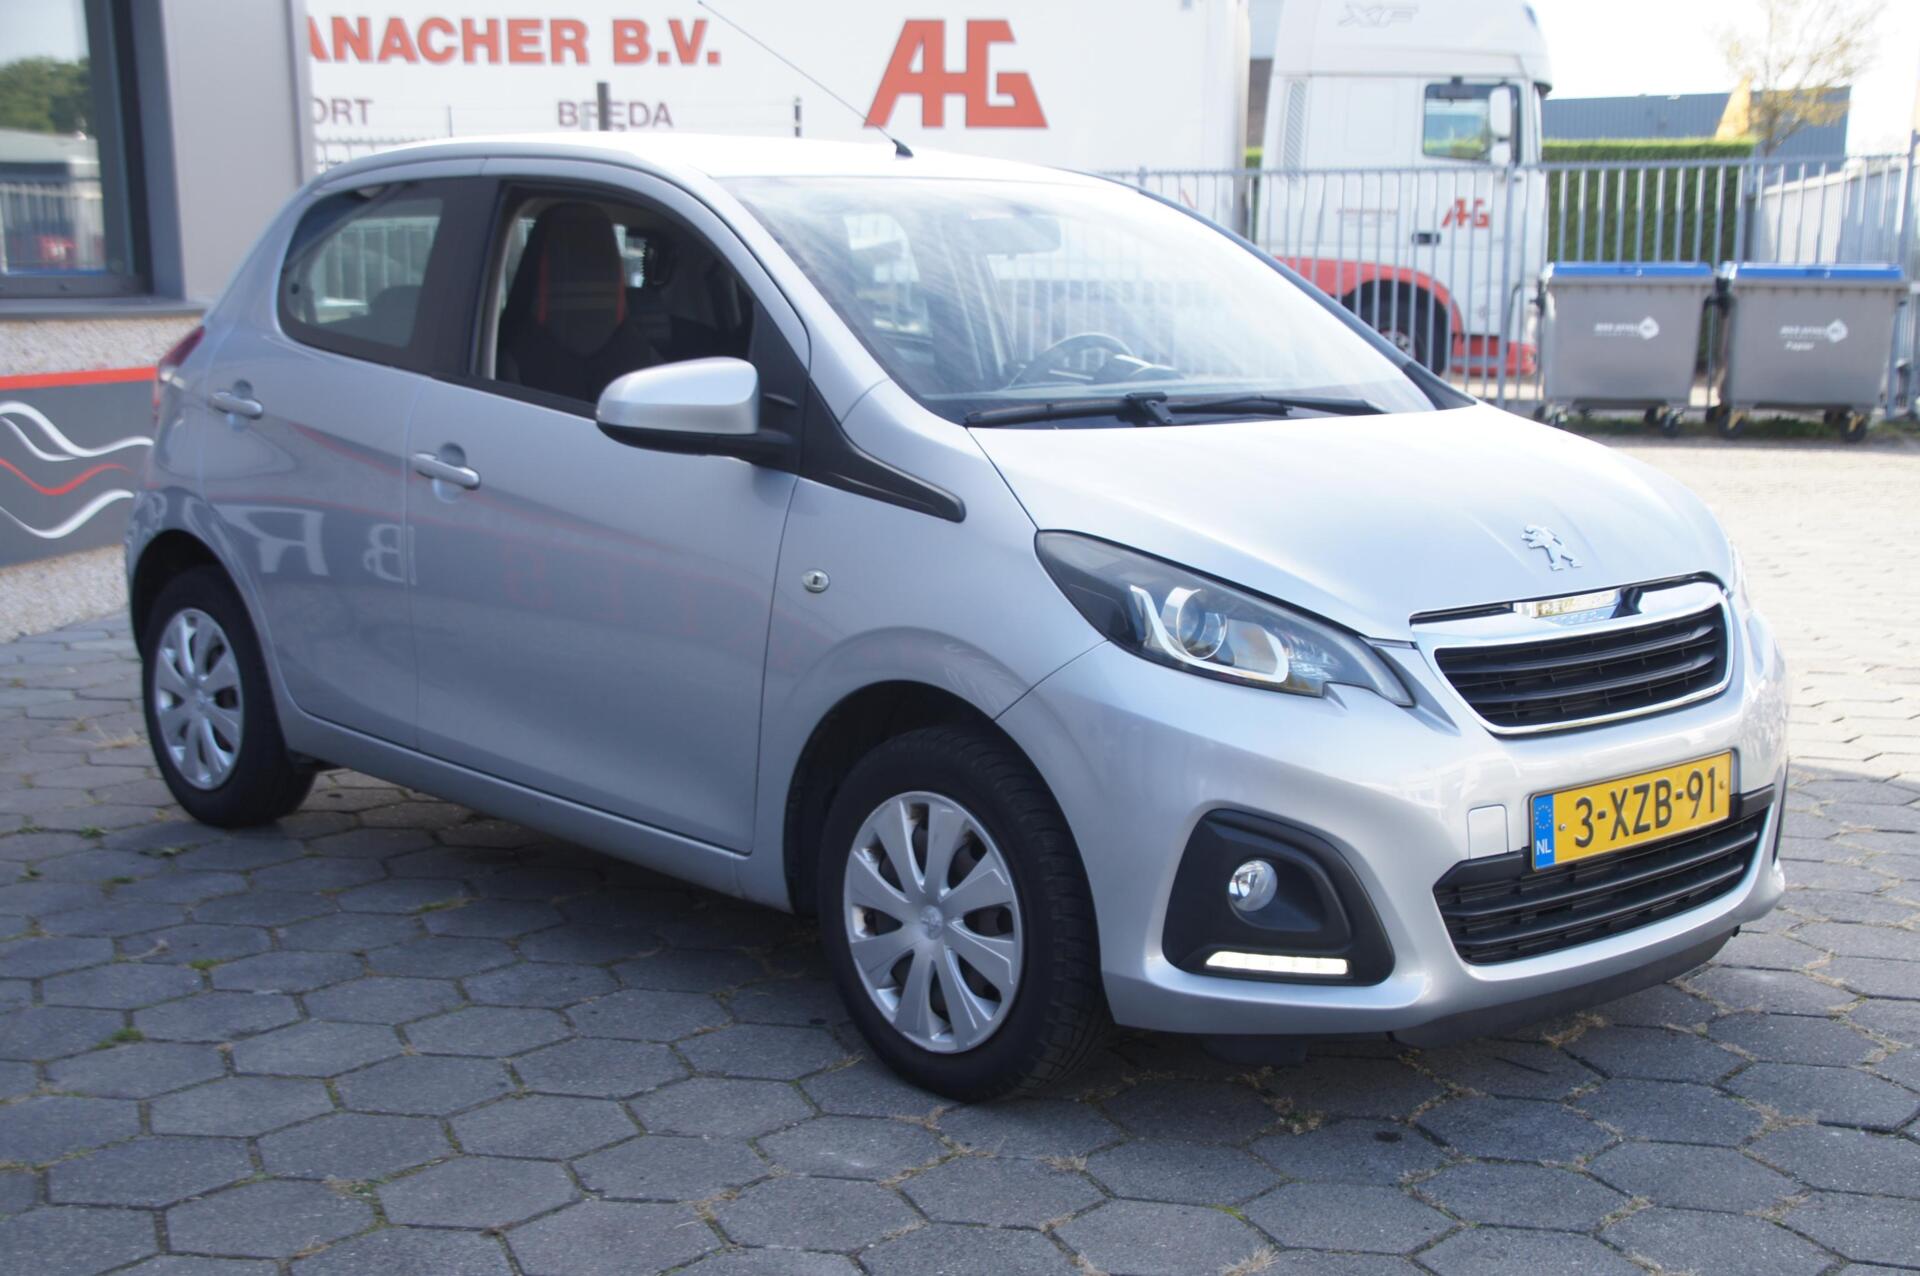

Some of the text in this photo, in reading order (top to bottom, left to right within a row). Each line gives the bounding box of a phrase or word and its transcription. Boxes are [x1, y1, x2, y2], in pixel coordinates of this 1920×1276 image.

[612, 19, 722, 65] B.V.
[862, 19, 1050, 128] AHG
[1575, 766, 1716, 848] 3-XZB-91
[1536, 838, 1552, 856] NL
